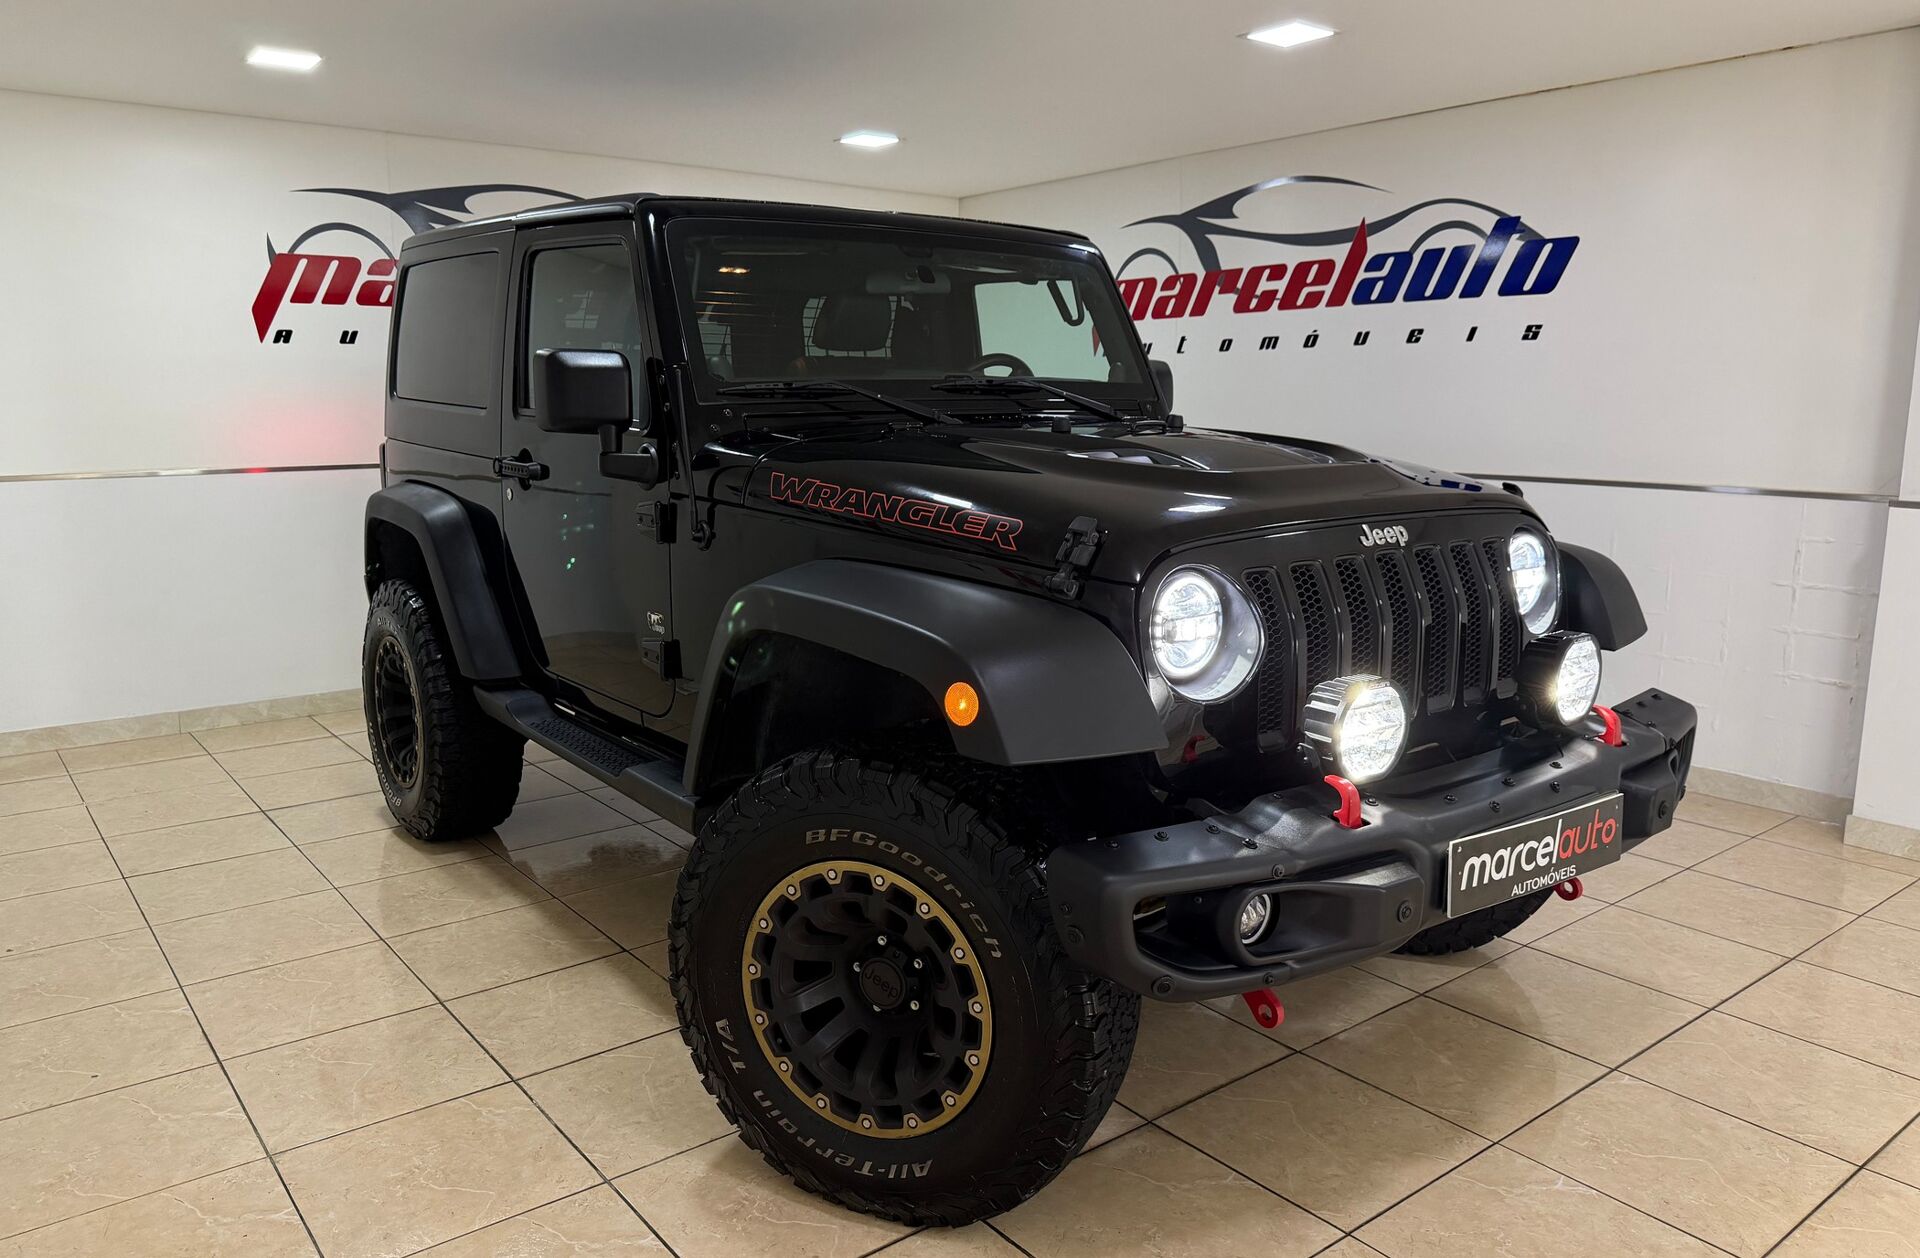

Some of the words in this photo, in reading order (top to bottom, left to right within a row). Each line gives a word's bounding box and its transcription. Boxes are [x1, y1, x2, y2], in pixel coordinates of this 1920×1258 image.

[770, 471, 1023, 550] WRANGLER
[1360, 523, 1408, 547] Jeep
[1460, 808, 1617, 891] marcelauto
[1511, 864, 1577, 897] AUTOMÓVEIS
[804, 828, 1002, 959] BFGoodrich
[864, 967, 899, 999] Jeep
[714, 1018, 747, 1075] T/A
[752, 1089, 934, 1180] All-Terrain
